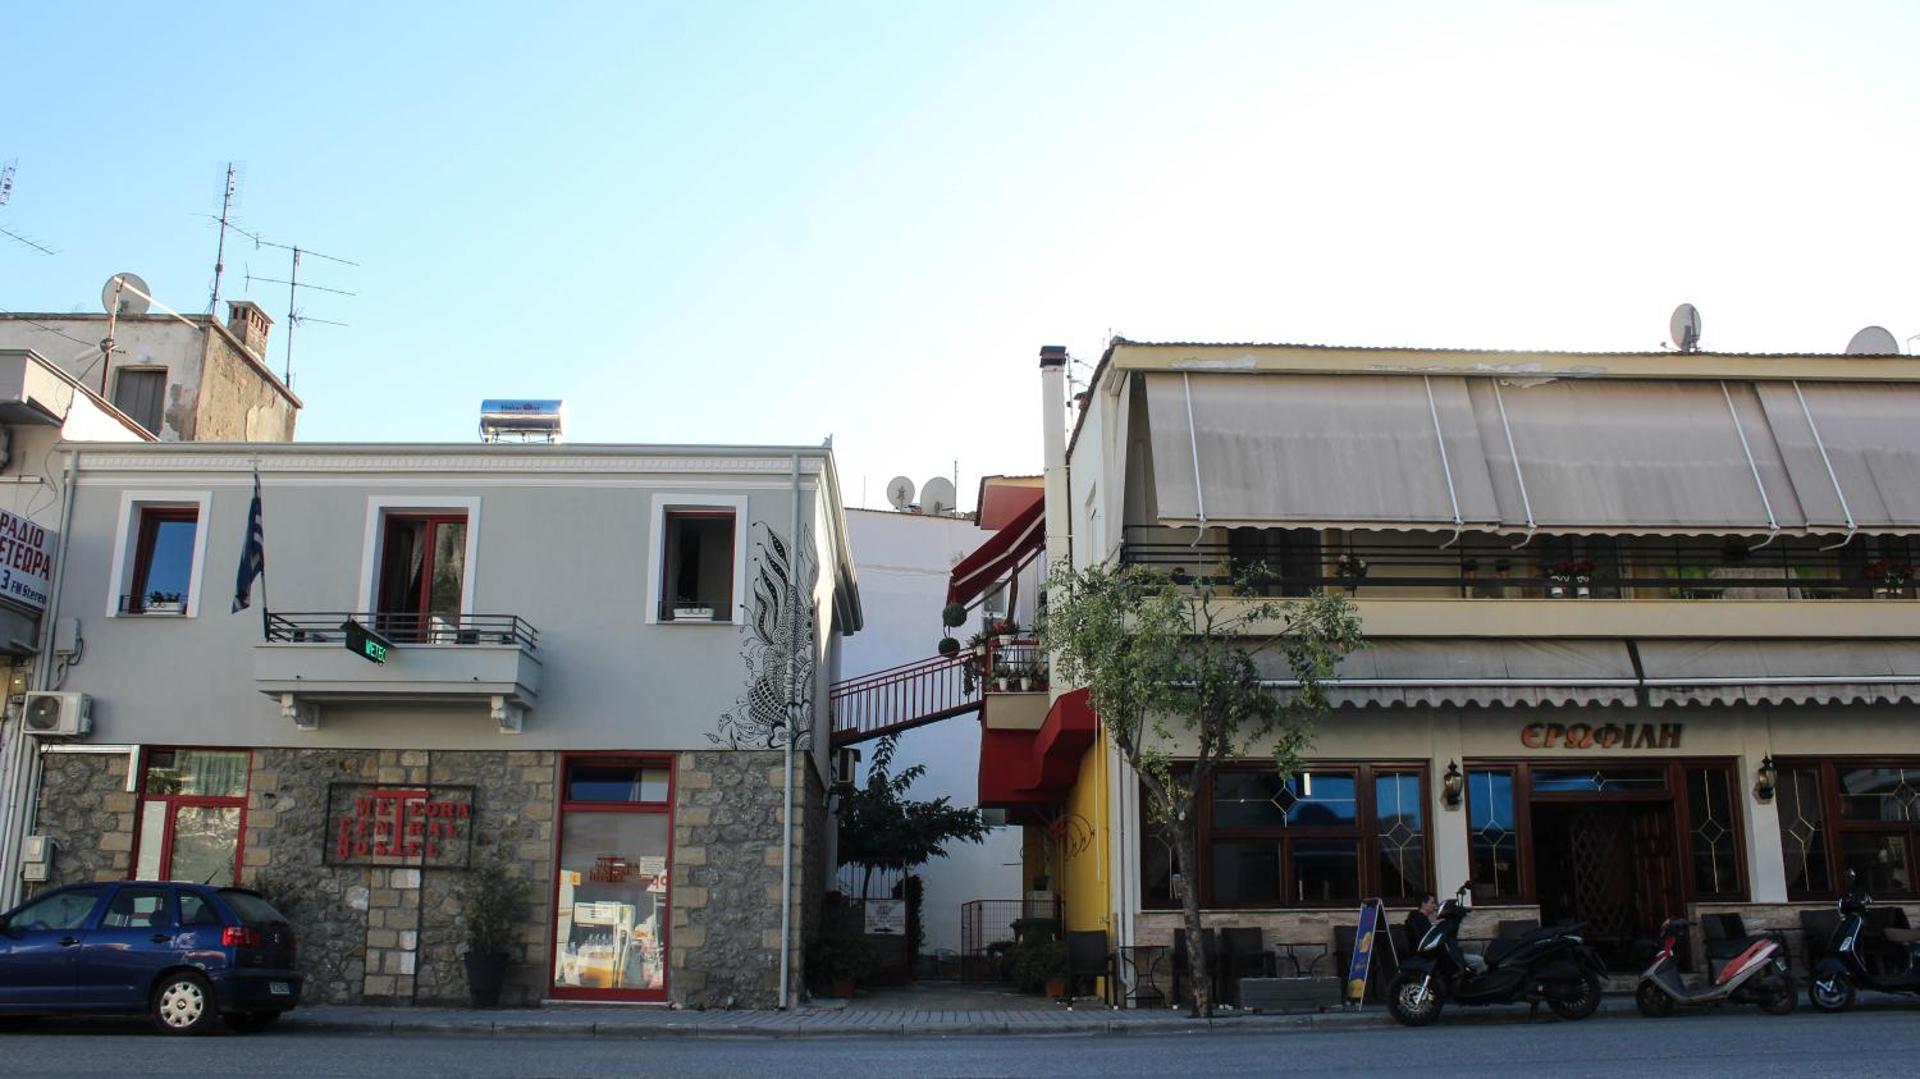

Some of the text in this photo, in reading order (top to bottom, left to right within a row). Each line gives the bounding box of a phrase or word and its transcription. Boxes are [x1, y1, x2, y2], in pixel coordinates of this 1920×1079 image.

[0, 513, 44, 548] ΡΑΔΙΟ
[22, 584, 47, 605] Stereo
[354, 790, 470, 818] METEORA
[337, 838, 441, 860] HOSTEL
